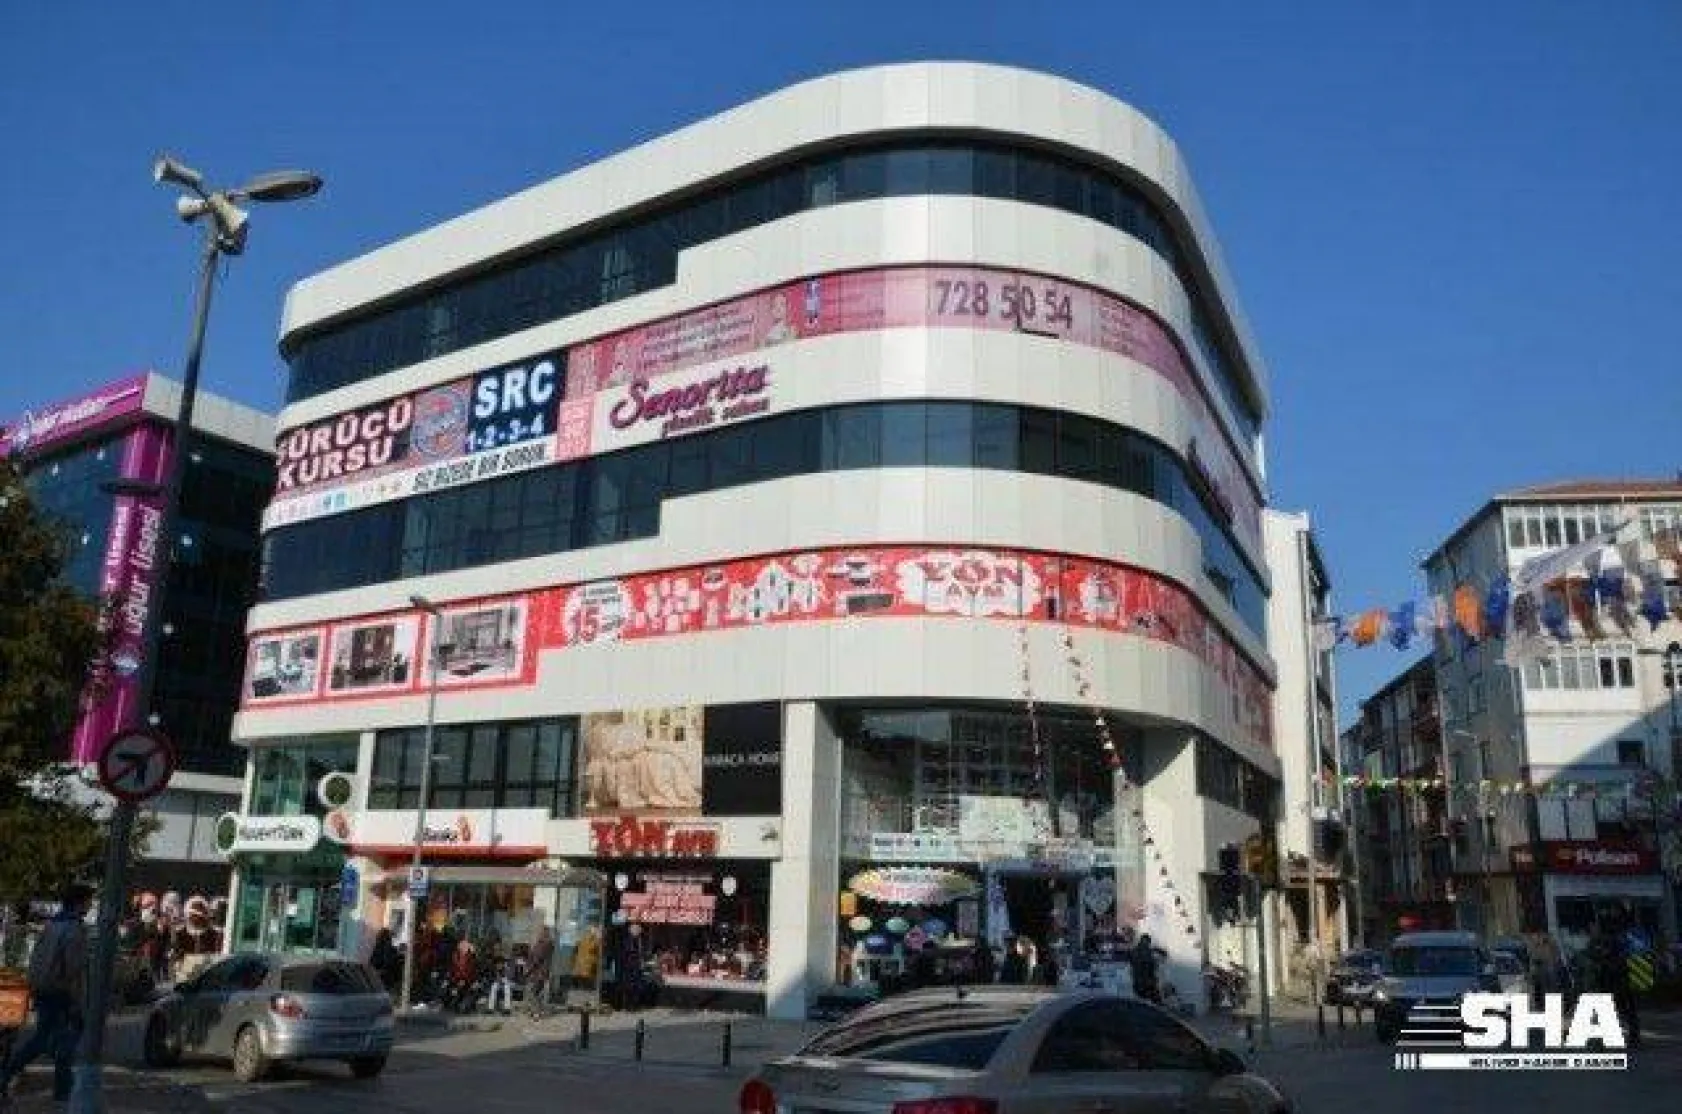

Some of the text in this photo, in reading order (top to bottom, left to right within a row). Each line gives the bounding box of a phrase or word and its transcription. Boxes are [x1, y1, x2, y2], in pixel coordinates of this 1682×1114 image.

[935, 280, 989, 316] 728
[1046, 289, 1073, 330] 54
[475, 360, 556, 419] SRC
[278, 437, 392, 490] KURSU
